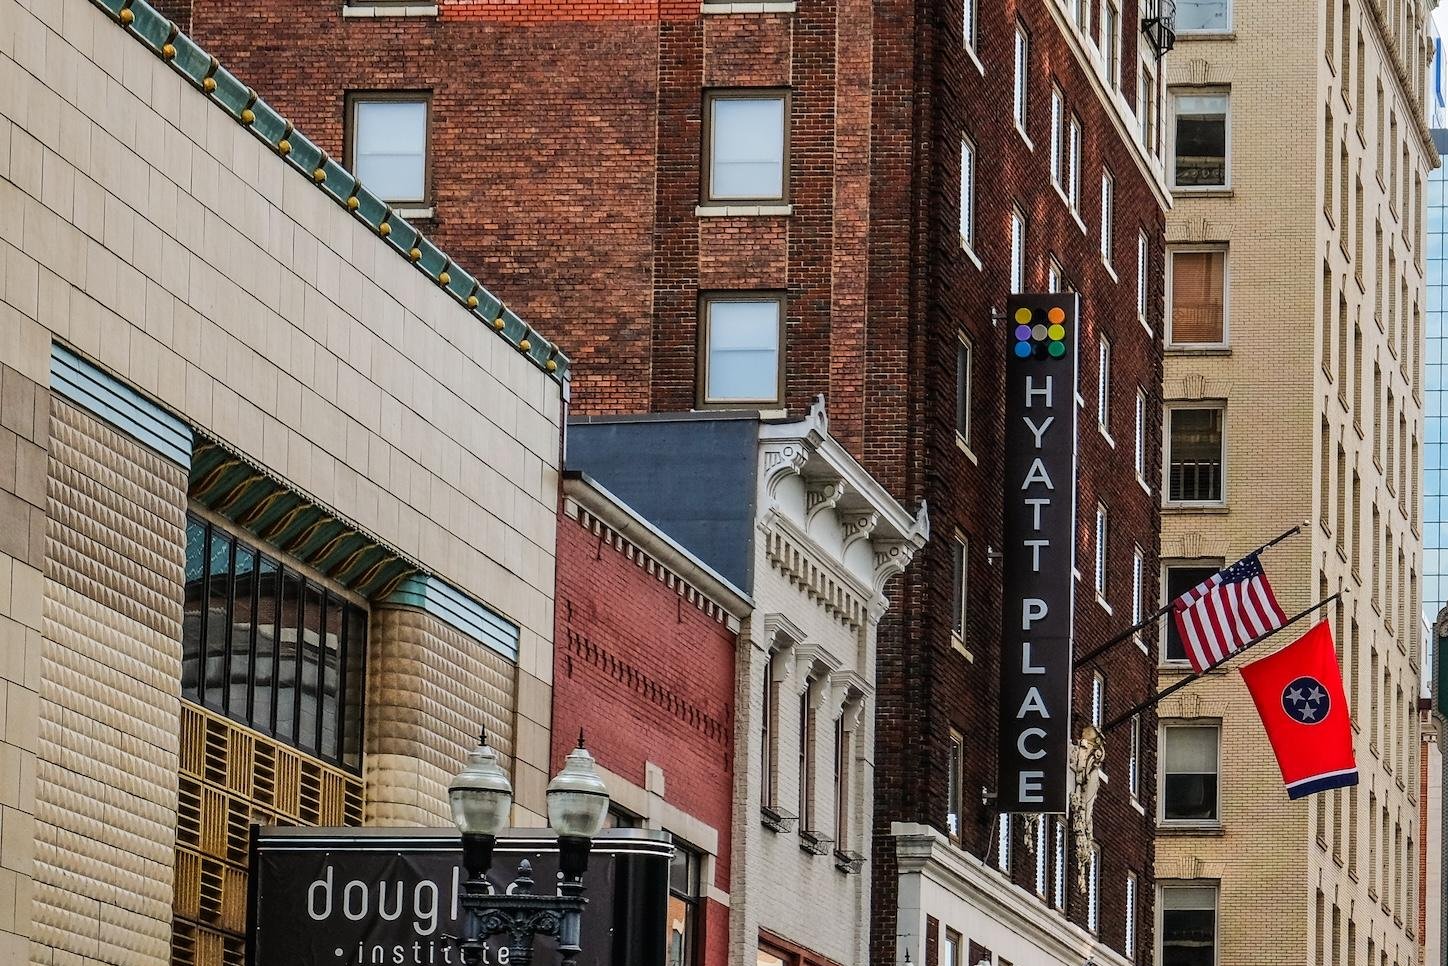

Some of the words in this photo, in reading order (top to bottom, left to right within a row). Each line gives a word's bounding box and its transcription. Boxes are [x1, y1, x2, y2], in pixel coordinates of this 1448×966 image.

[1021, 374, 1055, 573] HYATT
[1015, 597, 1052, 804] PLACE
[307, 865, 517, 936] dougl
